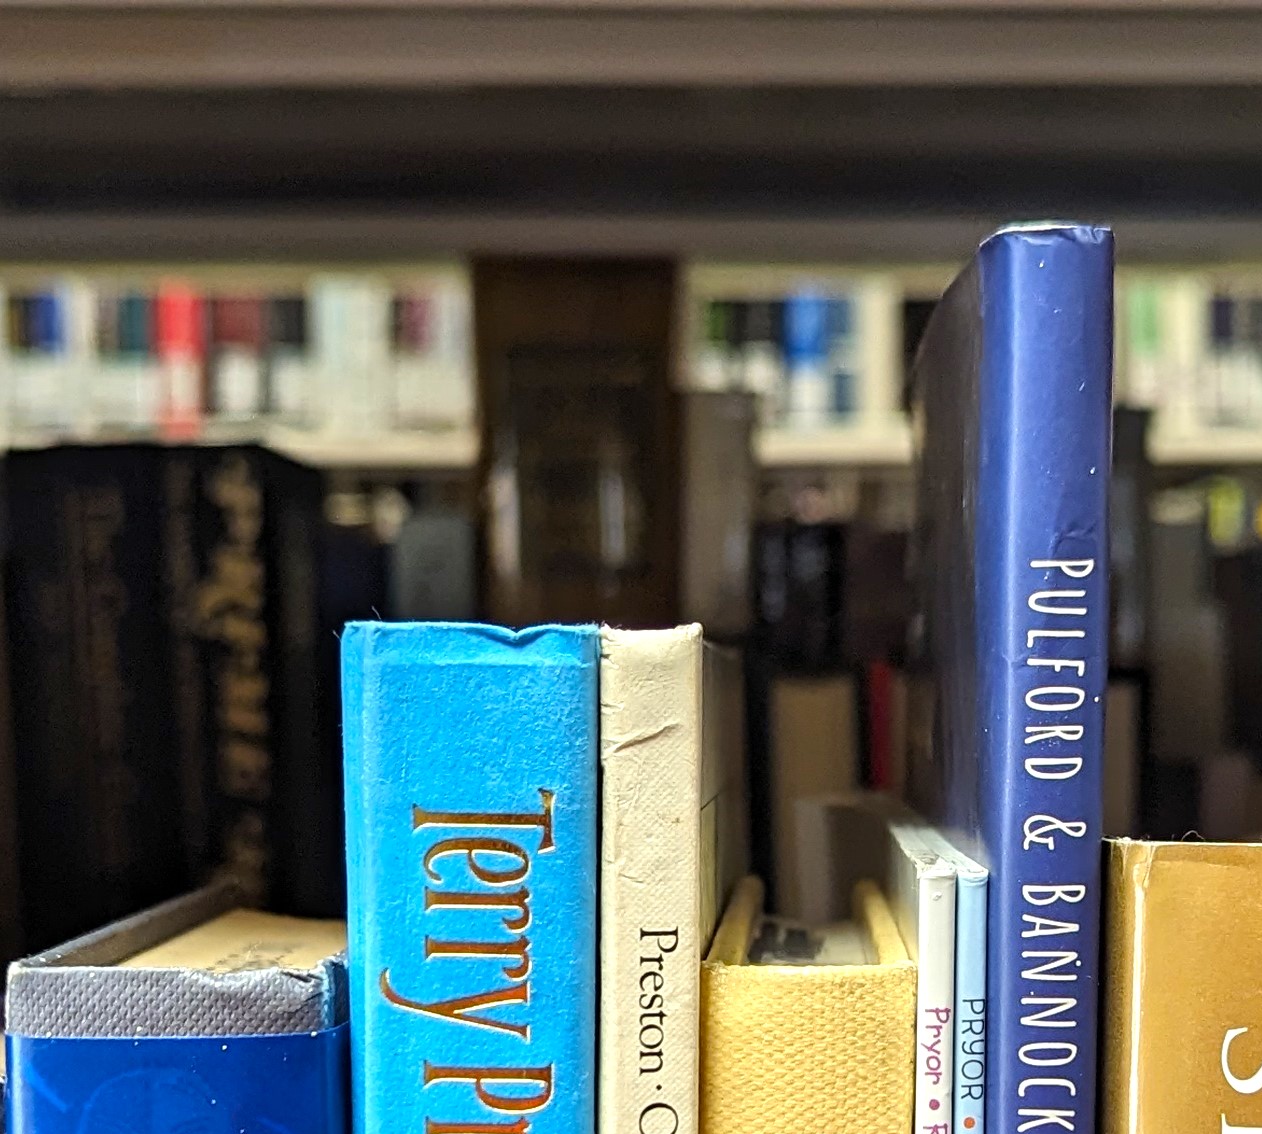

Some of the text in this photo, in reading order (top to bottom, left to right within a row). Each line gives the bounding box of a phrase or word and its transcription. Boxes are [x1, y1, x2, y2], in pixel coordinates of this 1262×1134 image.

[380, 787, 556, 1044] Terry
[1017, 557, 1095, 1133] PULFORD & BANNOCK
[638, 925, 679, 1077] Preston
[920, 1007, 951, 1085] Pryor
[960, 998, 986, 1101] PRYOR
